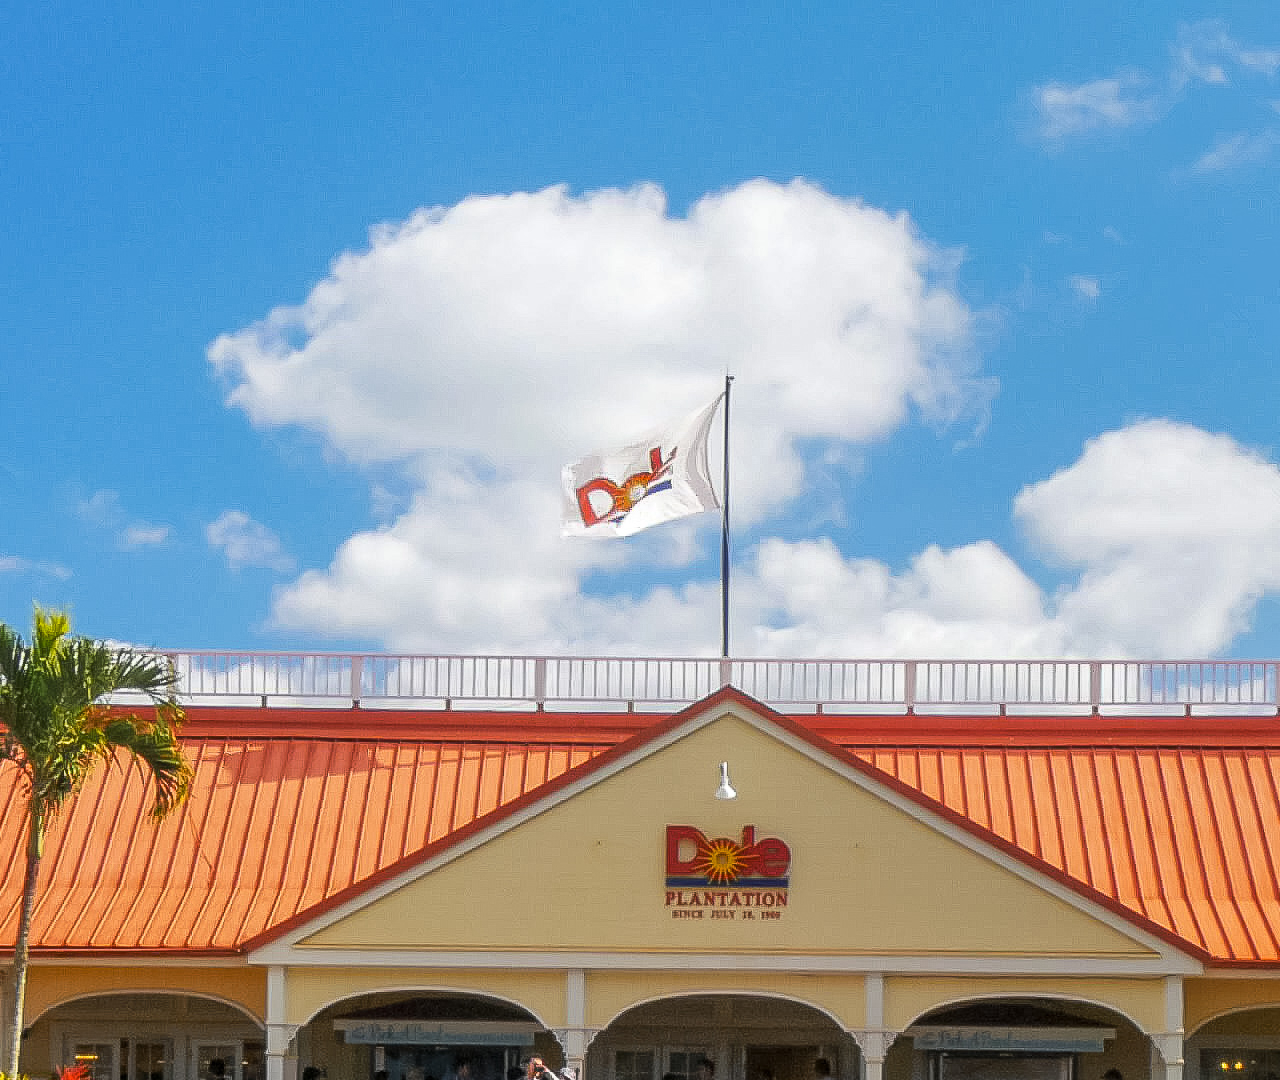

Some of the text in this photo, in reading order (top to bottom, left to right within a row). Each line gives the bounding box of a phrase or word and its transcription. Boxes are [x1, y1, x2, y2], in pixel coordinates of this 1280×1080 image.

[666, 825, 791, 882] Dole
[664, 891, 788, 906] PLANTATION
[671, 909, 704, 919] SINCE
[711, 909, 737, 919] JULY
